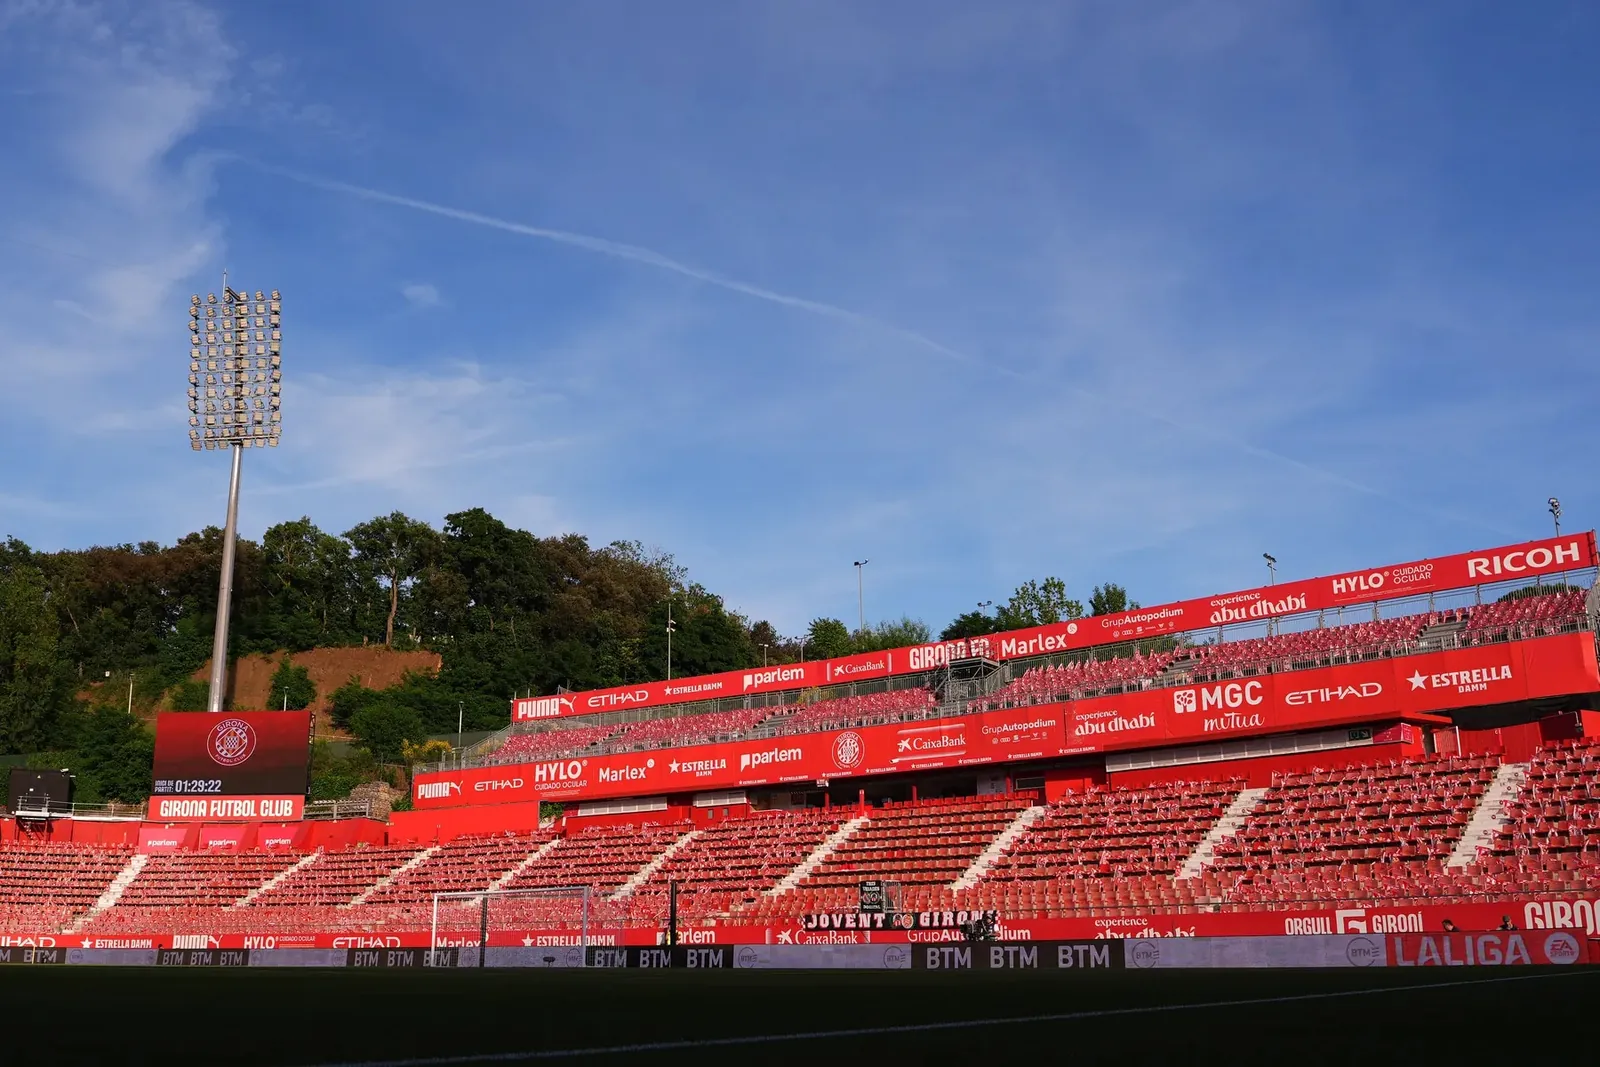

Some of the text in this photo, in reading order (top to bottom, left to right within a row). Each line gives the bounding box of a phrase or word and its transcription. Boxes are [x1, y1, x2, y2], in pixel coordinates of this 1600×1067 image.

[1467, 542, 1580, 578] RICOH
[1392, 563, 1434, 577] CUIDADO
[1393, 572, 1431, 585] OCULAR
[1210, 593, 1261, 607] experience
[1101, 608, 1184, 628] GrupAutopodium
[1210, 605, 1248, 624] abu
[1002, 633, 1067, 658] Marlex
[909, 640, 967, 670] GIRONA
[845, 659, 885, 675] CaixaBank
[754, 667, 805, 688] parlem
[1431, 664, 1512, 688] ESTRELLA
[672, 681, 723, 694] ESTRELLA DAMM
[1202, 680, 1263, 711] MGC
[1285, 682, 1383, 706] ETIHAD
[1458, 682, 1488, 693] DAMM
[588, 690, 649, 708] ETIHAD
[517, 697, 560, 719] PUMA
[1075, 709, 1118, 721] experience
[216, 720, 249, 732] GIRONA
[981, 719, 1056, 735] GrupAutopodium
[1075, 718, 1105, 736] abu
[1203, 711, 1265, 732] mutua
[913, 734, 966, 750] CaixaBank
[681, 759, 727, 773] ESTRELLA
[752, 747, 802, 769] parlem
[598, 765, 646, 782] Marlex
[175, 780, 222, 793] 01:29:22
[418, 781, 450, 799] PUMA
[474, 778, 524, 792] ETIHAD
[534, 780, 588, 791] CUIDADO OCULAR
[160, 799, 293, 817] GIRONA FUTBOL CLUB
[807, 910, 993, 929] JOVENT GIRON
[1095, 917, 1148, 928] experience
[1285, 917, 1332, 936] ORGULL
[0, 936, 56, 948] IHAD
[95, 938, 152, 949] ESTRELLA DAMM
[333, 936, 401, 948] ETIHAD
[536, 934, 615, 947] ESTRELLA DAMM
[673, 930, 716, 945] arlem
[795, 929, 858, 945] CaixaBank
[926, 945, 1110, 969] BTM BTM BTM
[1394, 934, 1533, 966] LALIGA
[162, 952, 184, 965] BTM
[190, 952, 213, 966] BTM
[220, 952, 243, 966] BTM
[354, 952, 379, 967] BTM
[387, 951, 415, 967] BTM
[595, 949, 628, 968] BTM
[687, 949, 723, 968] BTM
